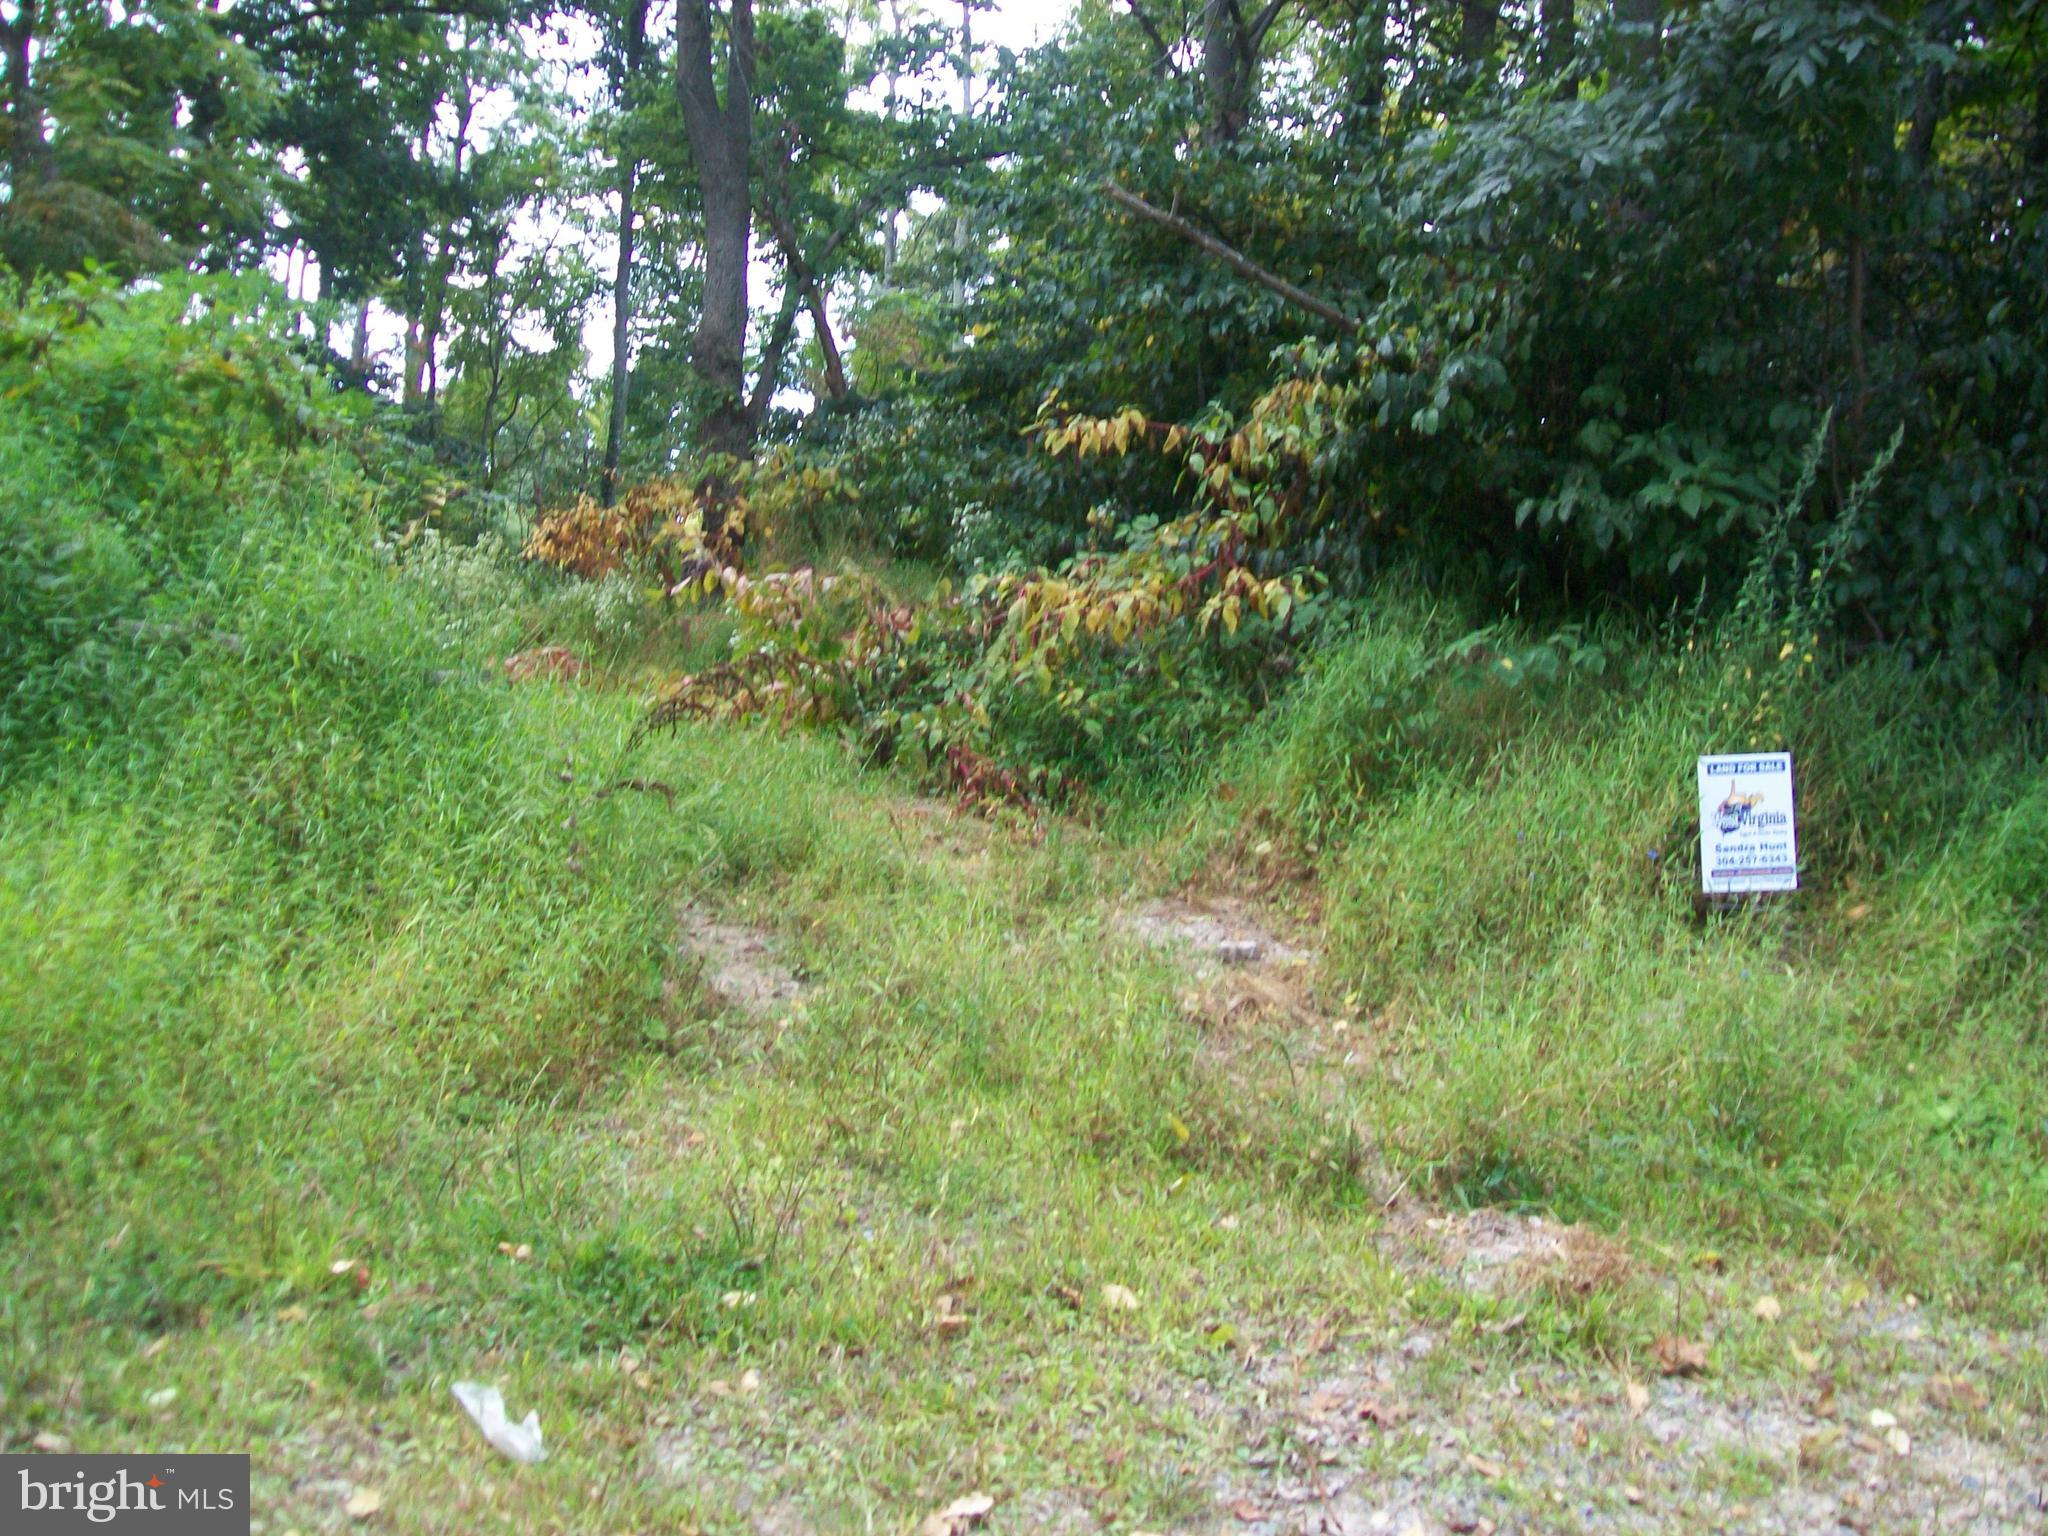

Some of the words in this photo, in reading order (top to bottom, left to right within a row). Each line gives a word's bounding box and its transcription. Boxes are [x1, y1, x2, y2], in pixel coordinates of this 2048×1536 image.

[1741, 809, 1787, 828] Virginia
[1715, 842, 1756, 853] Sandra
[1760, 841, 1787, 850] Hunt
